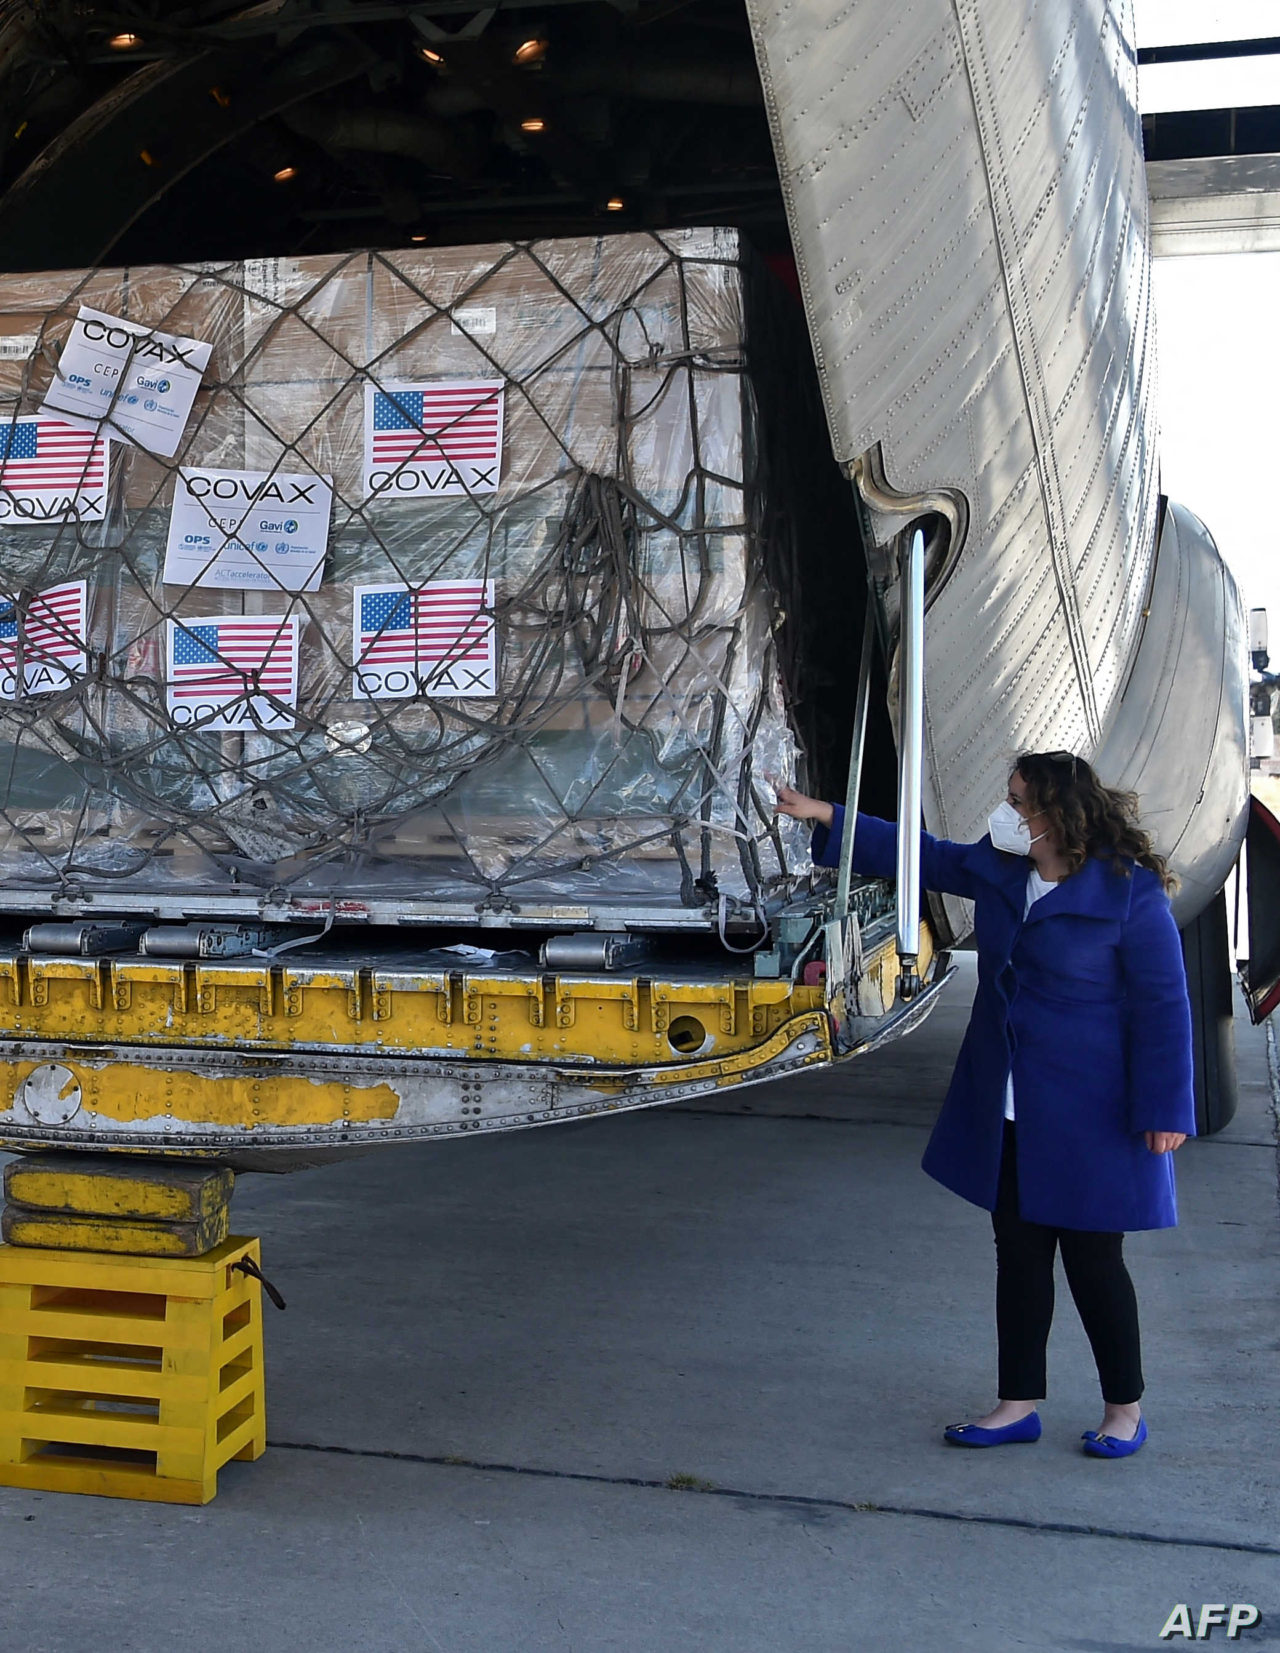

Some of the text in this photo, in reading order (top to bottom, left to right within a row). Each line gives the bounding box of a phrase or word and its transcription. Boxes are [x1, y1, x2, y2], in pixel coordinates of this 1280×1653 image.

[83, 320, 193, 364] COVAX
[94, 363, 122, 379] CEP
[69, 374, 92, 387] OPS
[137, 376, 158, 391] Gavi
[100, 388, 129, 402] unief
[369, 466, 497, 492] COVAX
[186, 477, 318, 504] COVAX
[260, 520, 283, 530] Gavi
[184, 535, 211, 545] OPS
[171, 702, 293, 727] COVAX
